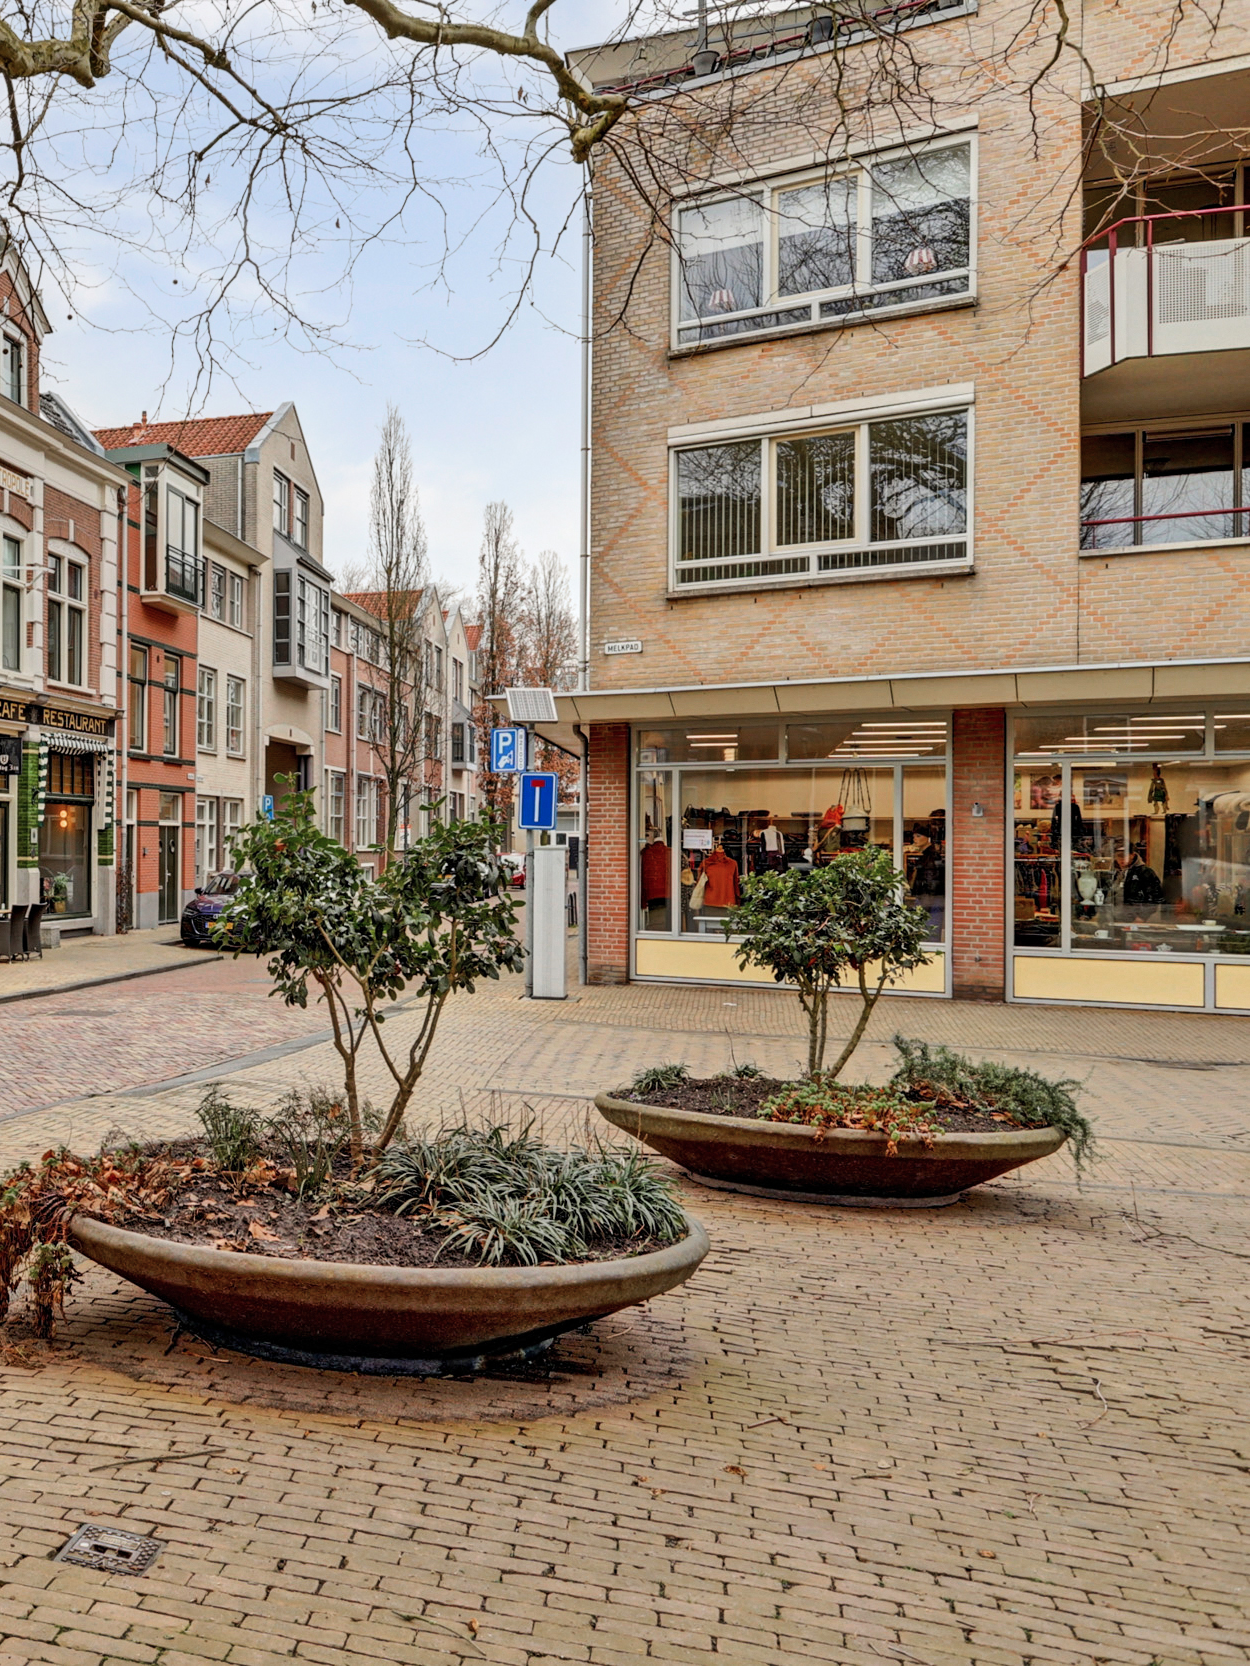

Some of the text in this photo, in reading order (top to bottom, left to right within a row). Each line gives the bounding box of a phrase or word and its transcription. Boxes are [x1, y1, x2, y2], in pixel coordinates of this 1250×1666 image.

[607, 643, 639, 652] MELKPAD
[43, 708, 107, 734] RESTAURANT
[498, 732, 512, 754] P
